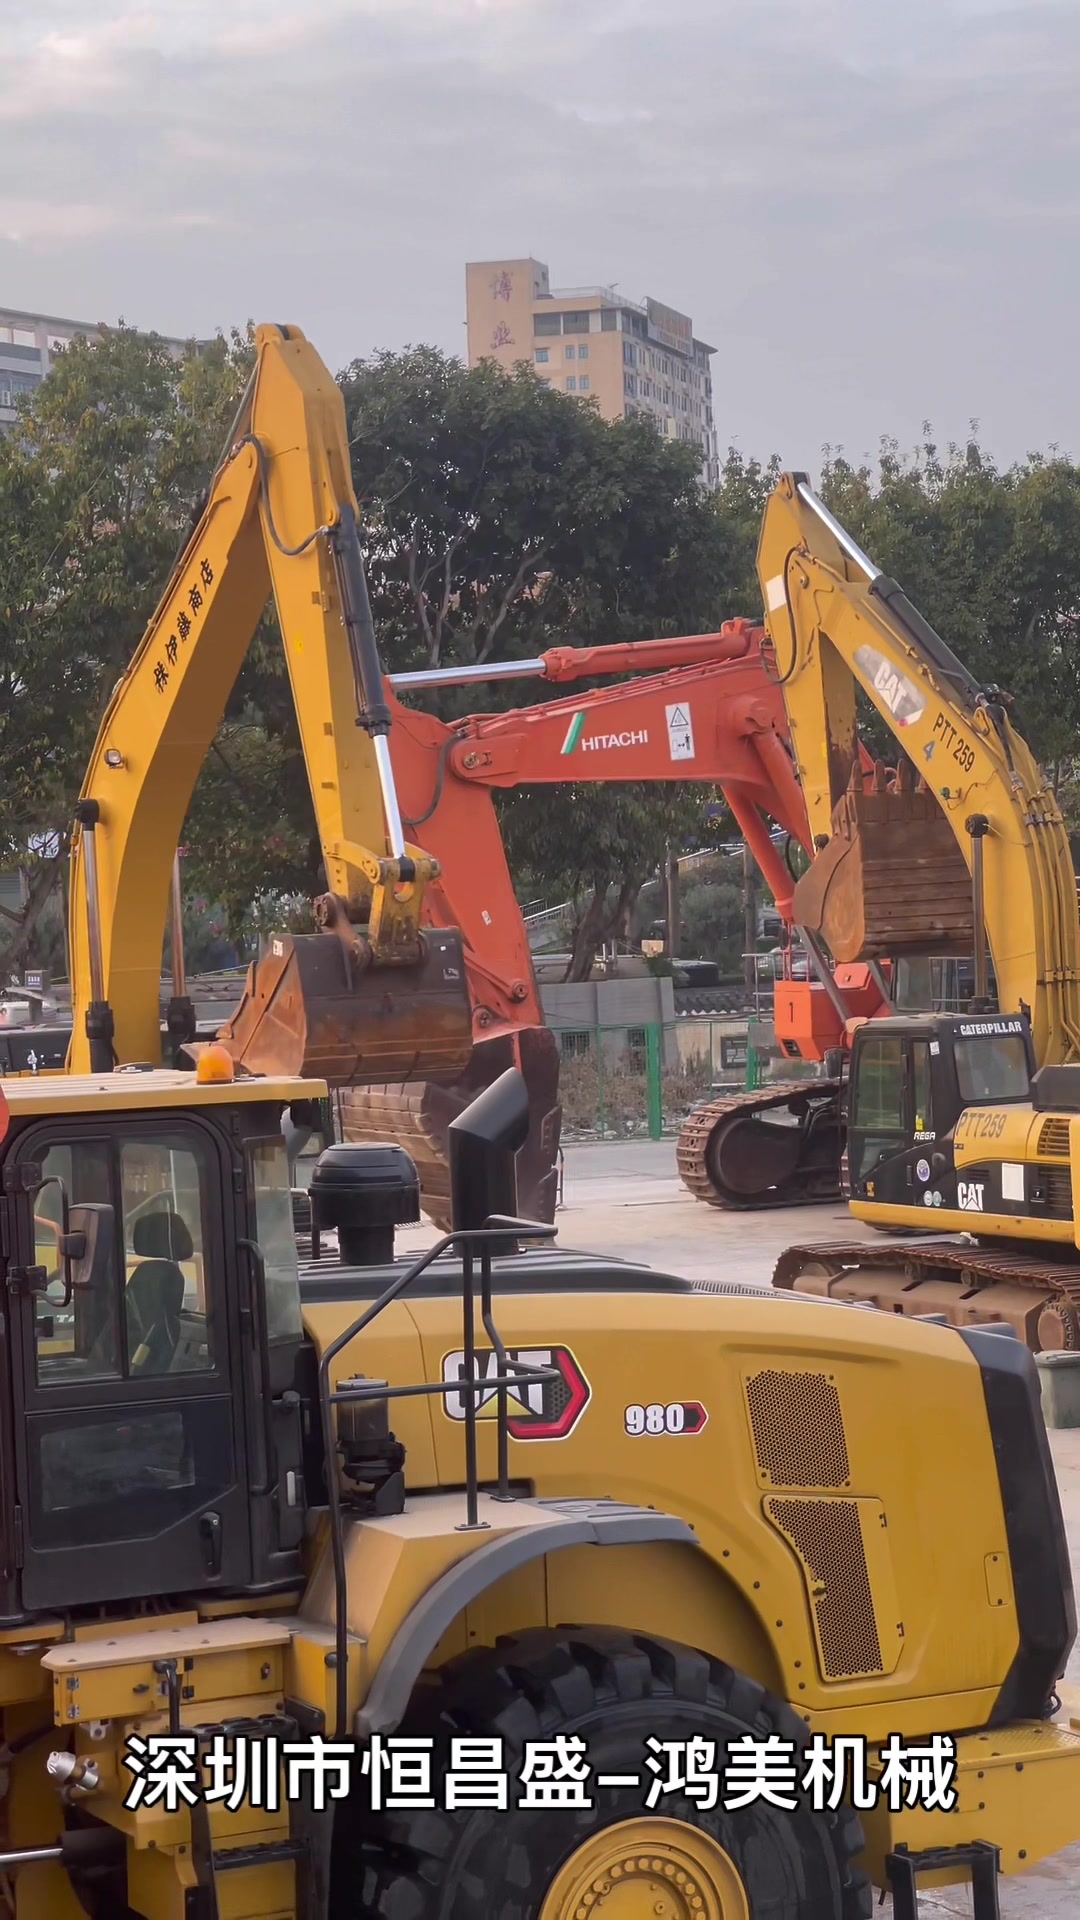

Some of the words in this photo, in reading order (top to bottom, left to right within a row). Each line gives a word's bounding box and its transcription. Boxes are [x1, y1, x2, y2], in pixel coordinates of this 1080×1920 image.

[873, 660, 908, 714] CAT
[581, 729, 649, 752] HITACHI
[952, 738, 976, 773] 259
[960, 1021, 1023, 1036] CATERPILLAR
[913, 1131, 936, 1141] REGA
[957, 1182, 985, 1212] CAT
[625, 1404, 685, 1435] 980
